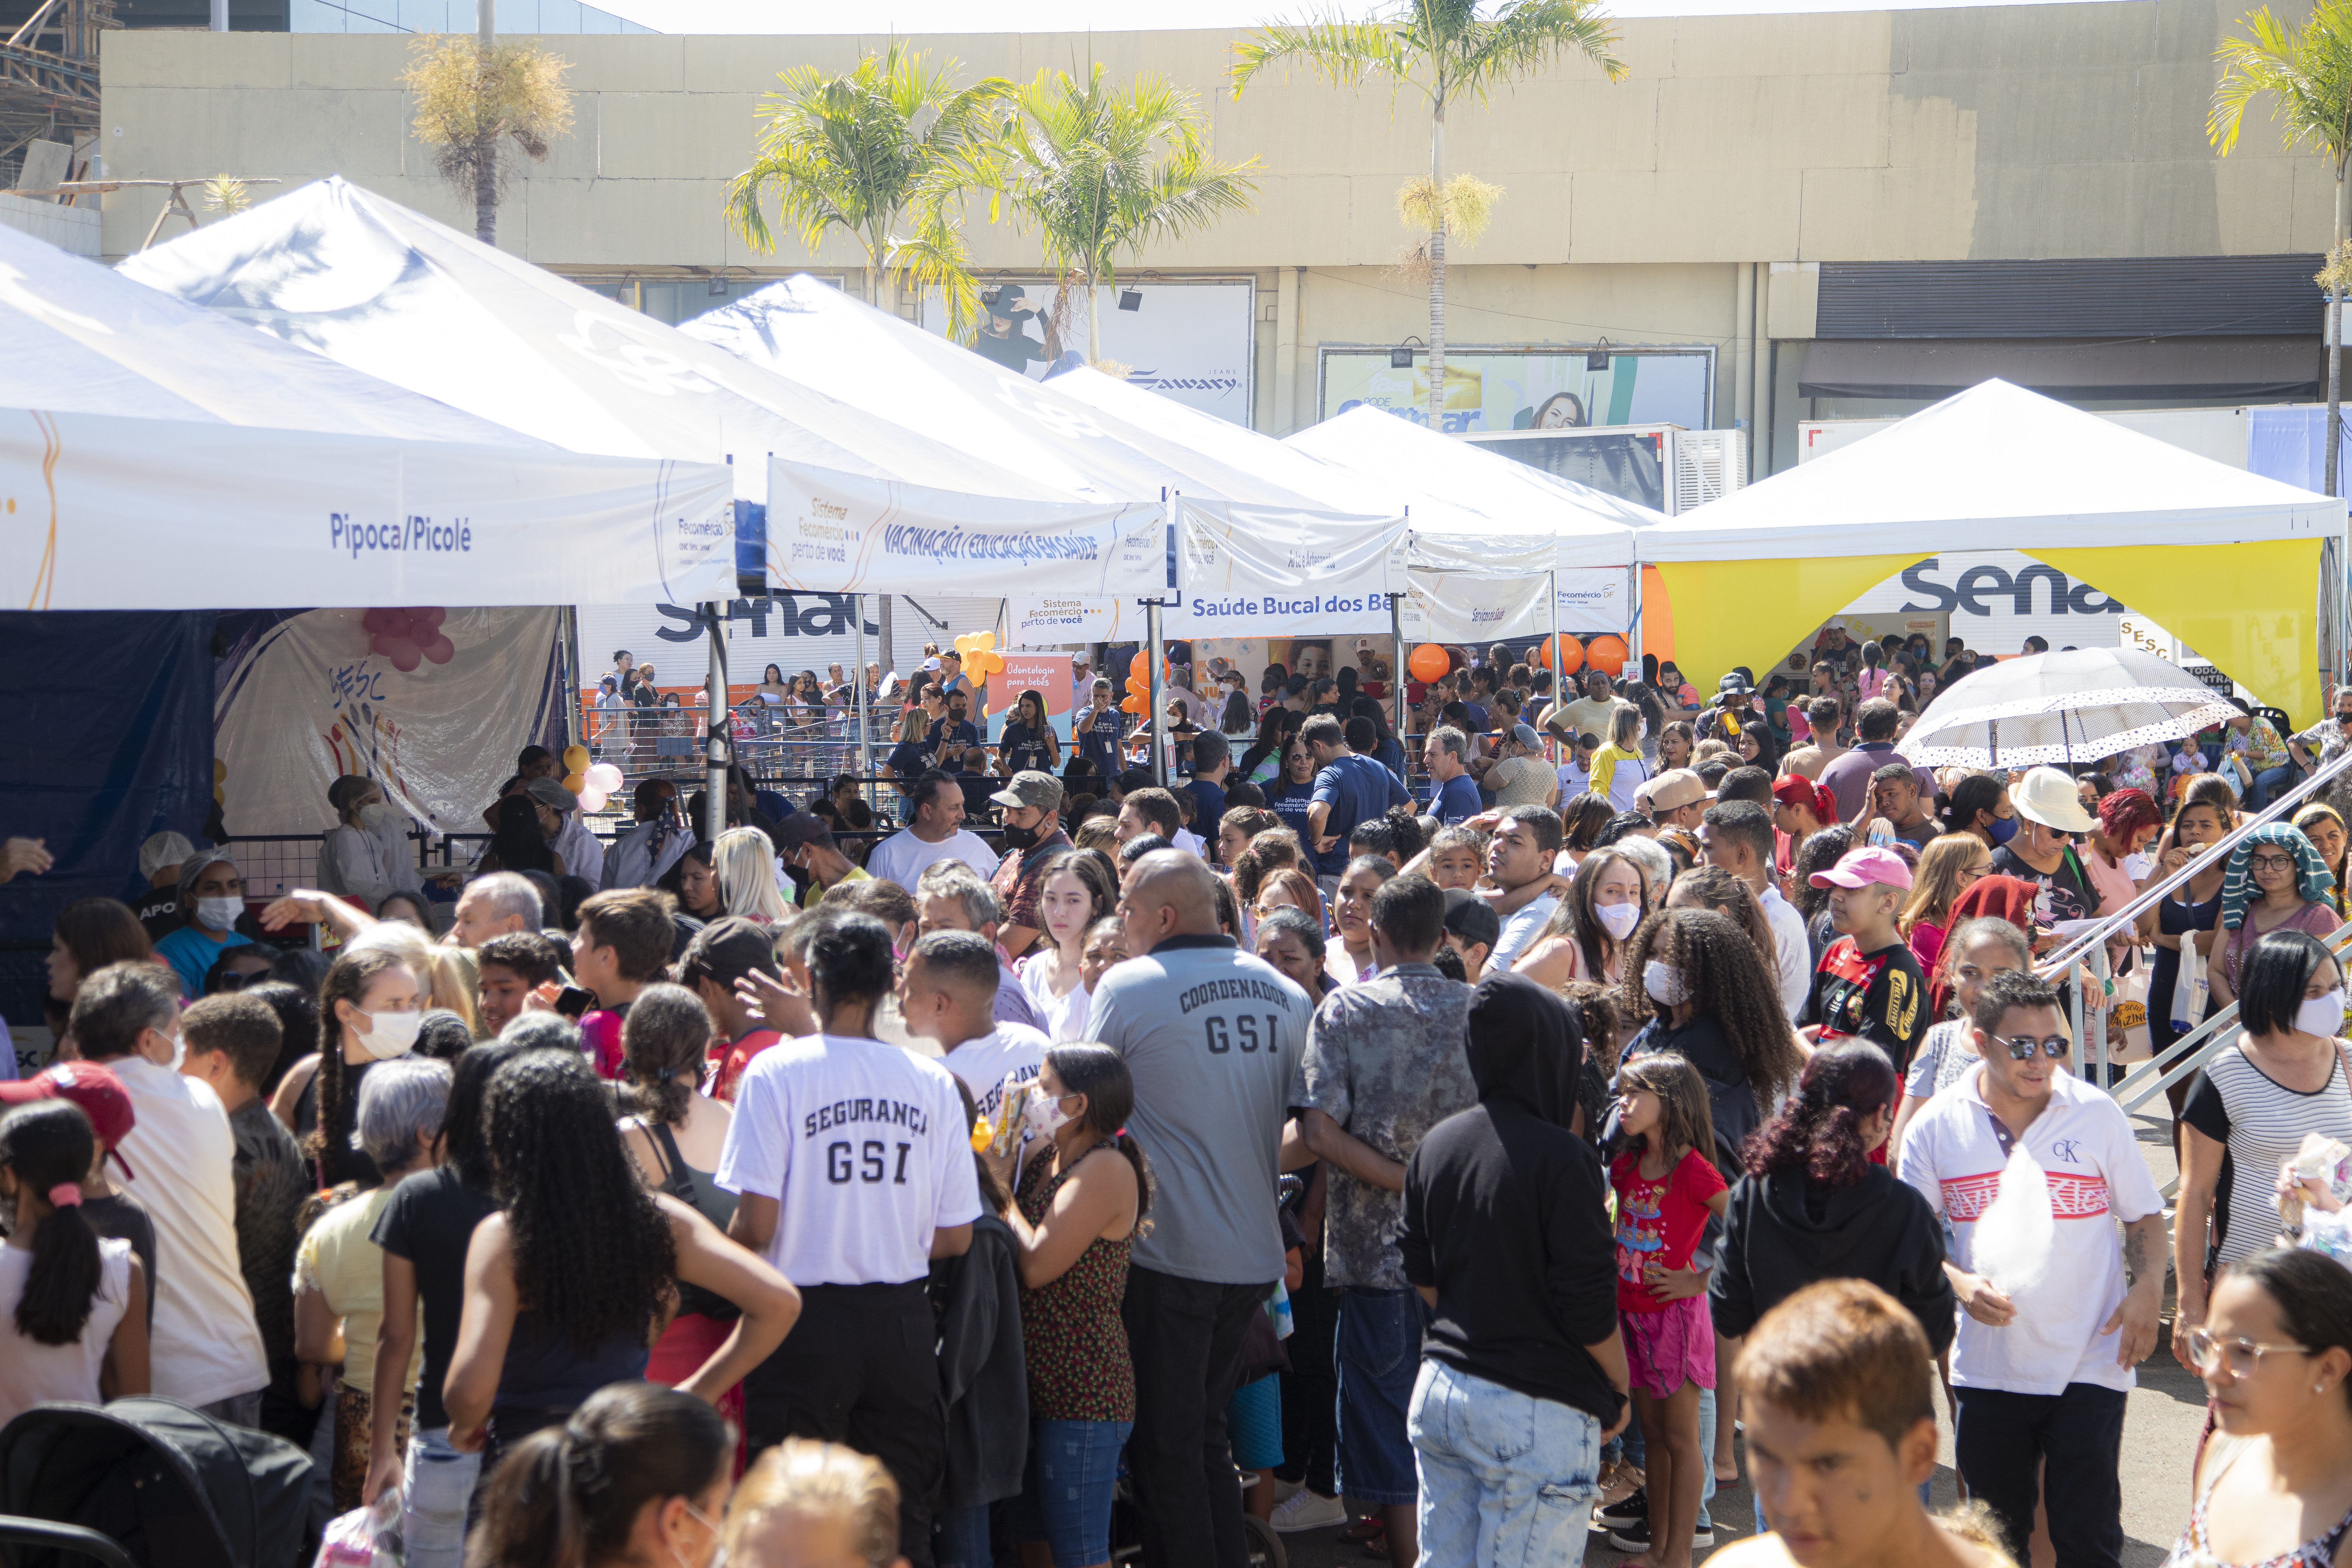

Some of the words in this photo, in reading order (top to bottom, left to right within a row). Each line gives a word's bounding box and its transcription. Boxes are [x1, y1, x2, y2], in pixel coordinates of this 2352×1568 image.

[1368, 372, 1413, 394] fazer
[1364, 397, 1392, 406] PODE
[812, 497, 847, 521] Sistema
[330, 513, 471, 559] Pipoca/Picolé
[679, 518, 723, 536] Fecomércio
[799, 517, 844, 541] Fecomércio
[884, 524, 964, 565] VACINAÇÃO
[969, 531, 1042, 566] EDUCAÇÃO
[1041, 535, 1063, 559] EM
[1061, 529, 1098, 561] SAÚDE
[1125, 534, 1150, 548] Fecomércio
[1151, 535, 1157, 548] DF
[792, 541, 813, 562] perto
[816, 544, 825, 560] de
[827, 543, 845, 563] você
[1203, 551, 1214, 565] você
[1289, 550, 1301, 568] Arte
[1302, 556, 1305, 568] e
[1305, 551, 1335, 569] Artesanato
[1408, 587, 1424, 599] Sistema
[1900, 558, 2125, 617] Sena
[1029, 606, 1082, 618] Fecomércio
[1043, 600, 1082, 608] Sistema
[1192, 597, 1258, 617] Saúde
[1263, 596, 1320, 615] Bucal
[1325, 595, 1363, 613] dos
[1021, 617, 1045, 629] perto
[1047, 615, 1058, 625] de
[1060, 614, 1083, 624] você
[1410, 611, 1413, 621] de
[1472, 608, 1489, 626] Serviços
[2121, 622, 2167, 659] SESC
[1007, 663, 1054, 678] Odontologia
[2195, 674, 2232, 684] NTRA
[1007, 678, 1025, 689] para
[1028, 677, 1049, 686] bebês
[1890, 981, 1901, 1027] HELTRAN
[1205, 1014, 1278, 1054] GSI
[827, 1141, 913, 1185] GSI
